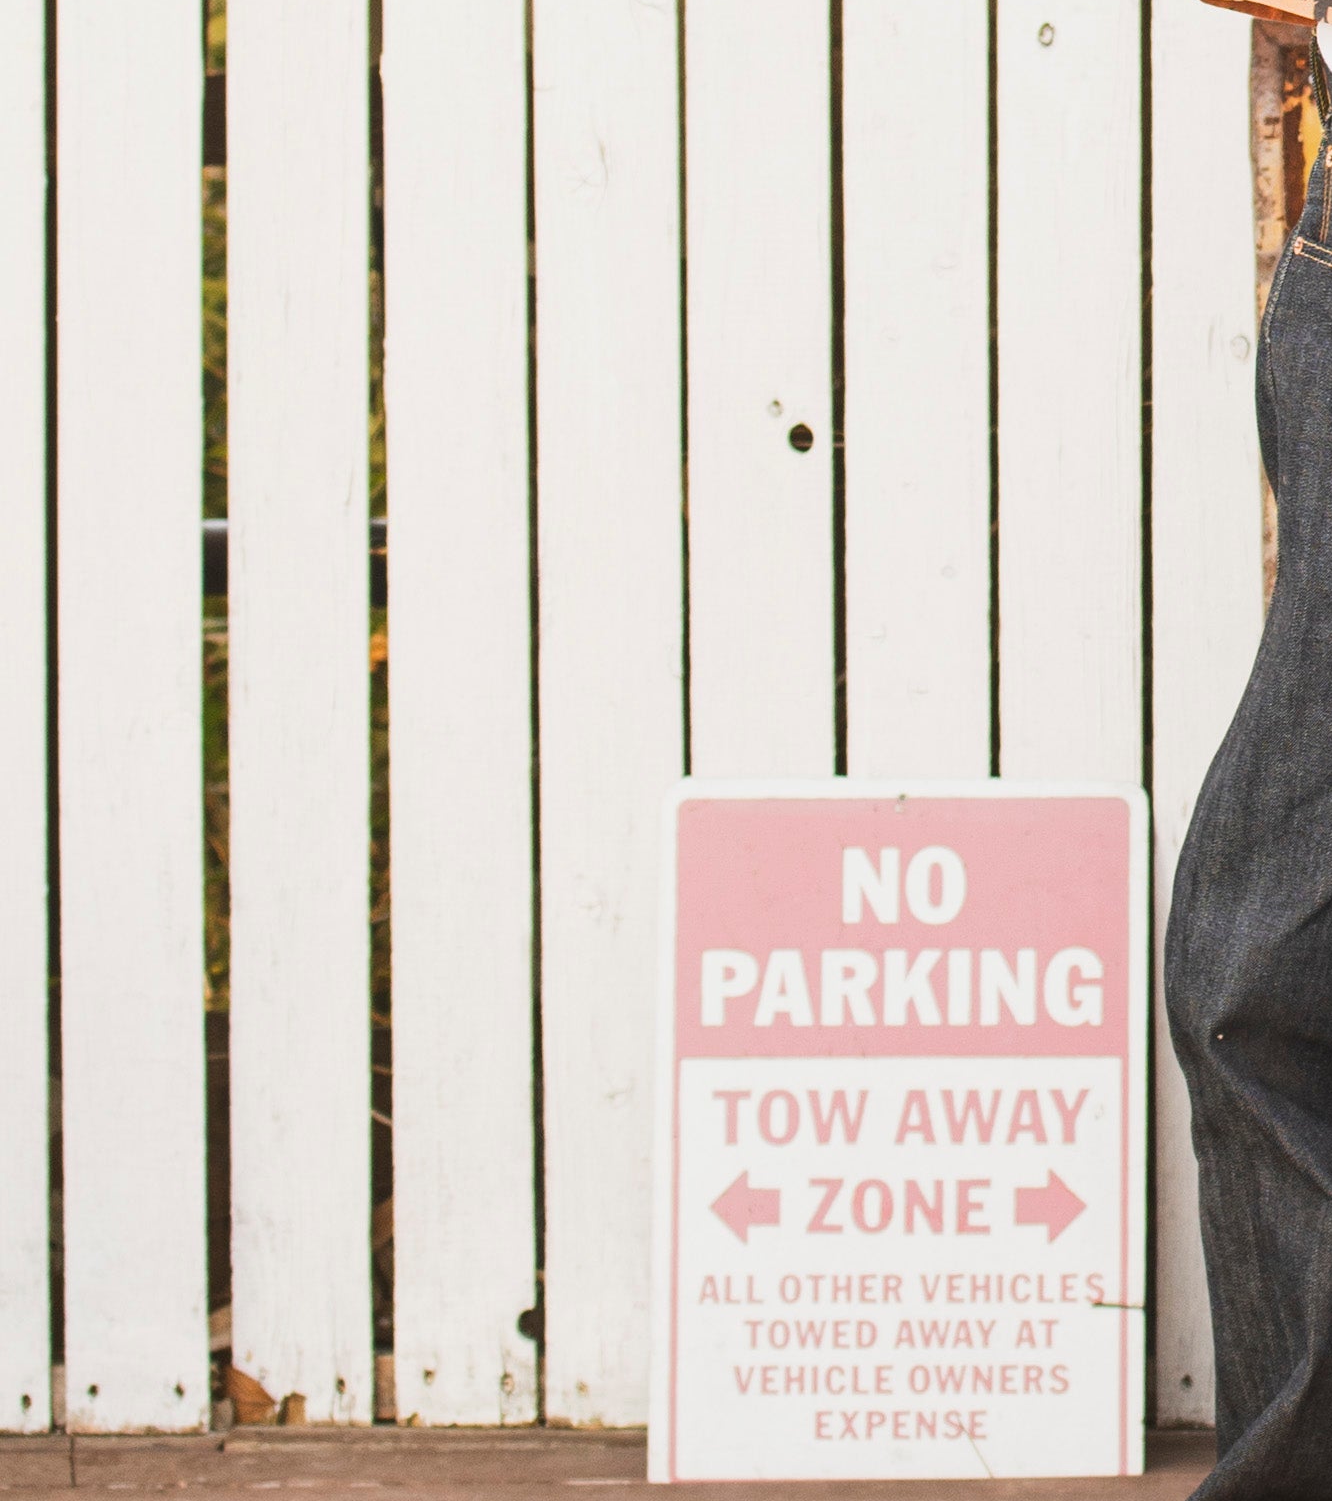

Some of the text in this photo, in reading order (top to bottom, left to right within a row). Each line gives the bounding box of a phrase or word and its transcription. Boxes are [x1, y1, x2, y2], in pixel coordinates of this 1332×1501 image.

[842, 845, 967, 925] NO
[701, 947, 1104, 1026] PARKING
[713, 1089, 1090, 1145] TOW AWAY
[806, 1178, 991, 1235] ZONE
[699, 1273, 1106, 1304] ALL OTHER VEHICLES
[745, 1319, 1060, 1349] TOWED AWAY AT
[733, 1364, 1070, 1394] VEHICLE OWNERS
[814, 1410, 987, 1440] EXPENSE
